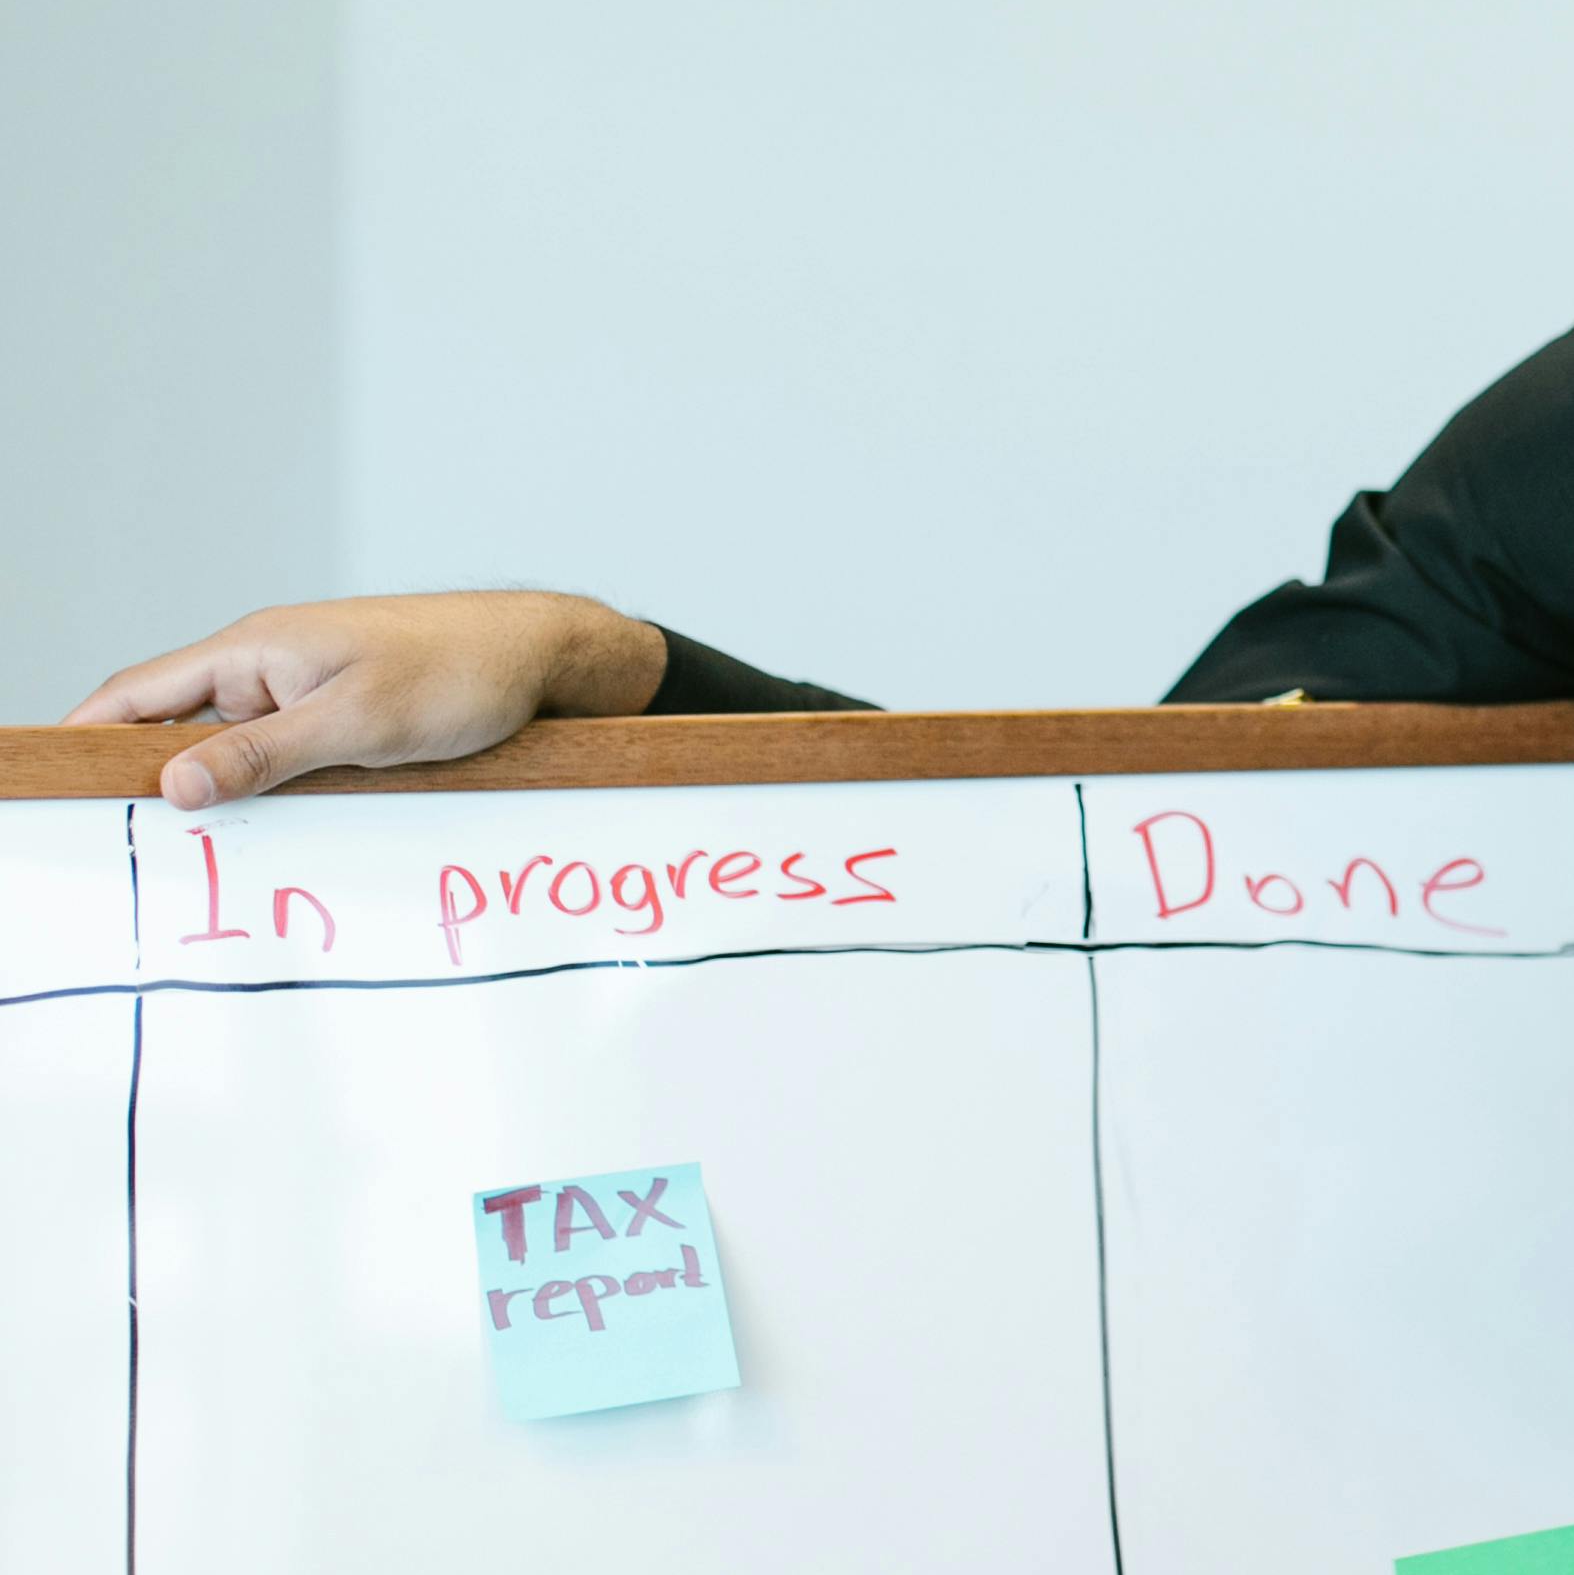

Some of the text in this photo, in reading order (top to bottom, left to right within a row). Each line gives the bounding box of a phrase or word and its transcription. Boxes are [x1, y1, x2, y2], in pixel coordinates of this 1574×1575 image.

[180, 817, 898, 967] In progress
[1132, 810, 1508, 938] Done
[483, 1177, 687, 1266] TAX
[486, 1243, 711, 1332] report
